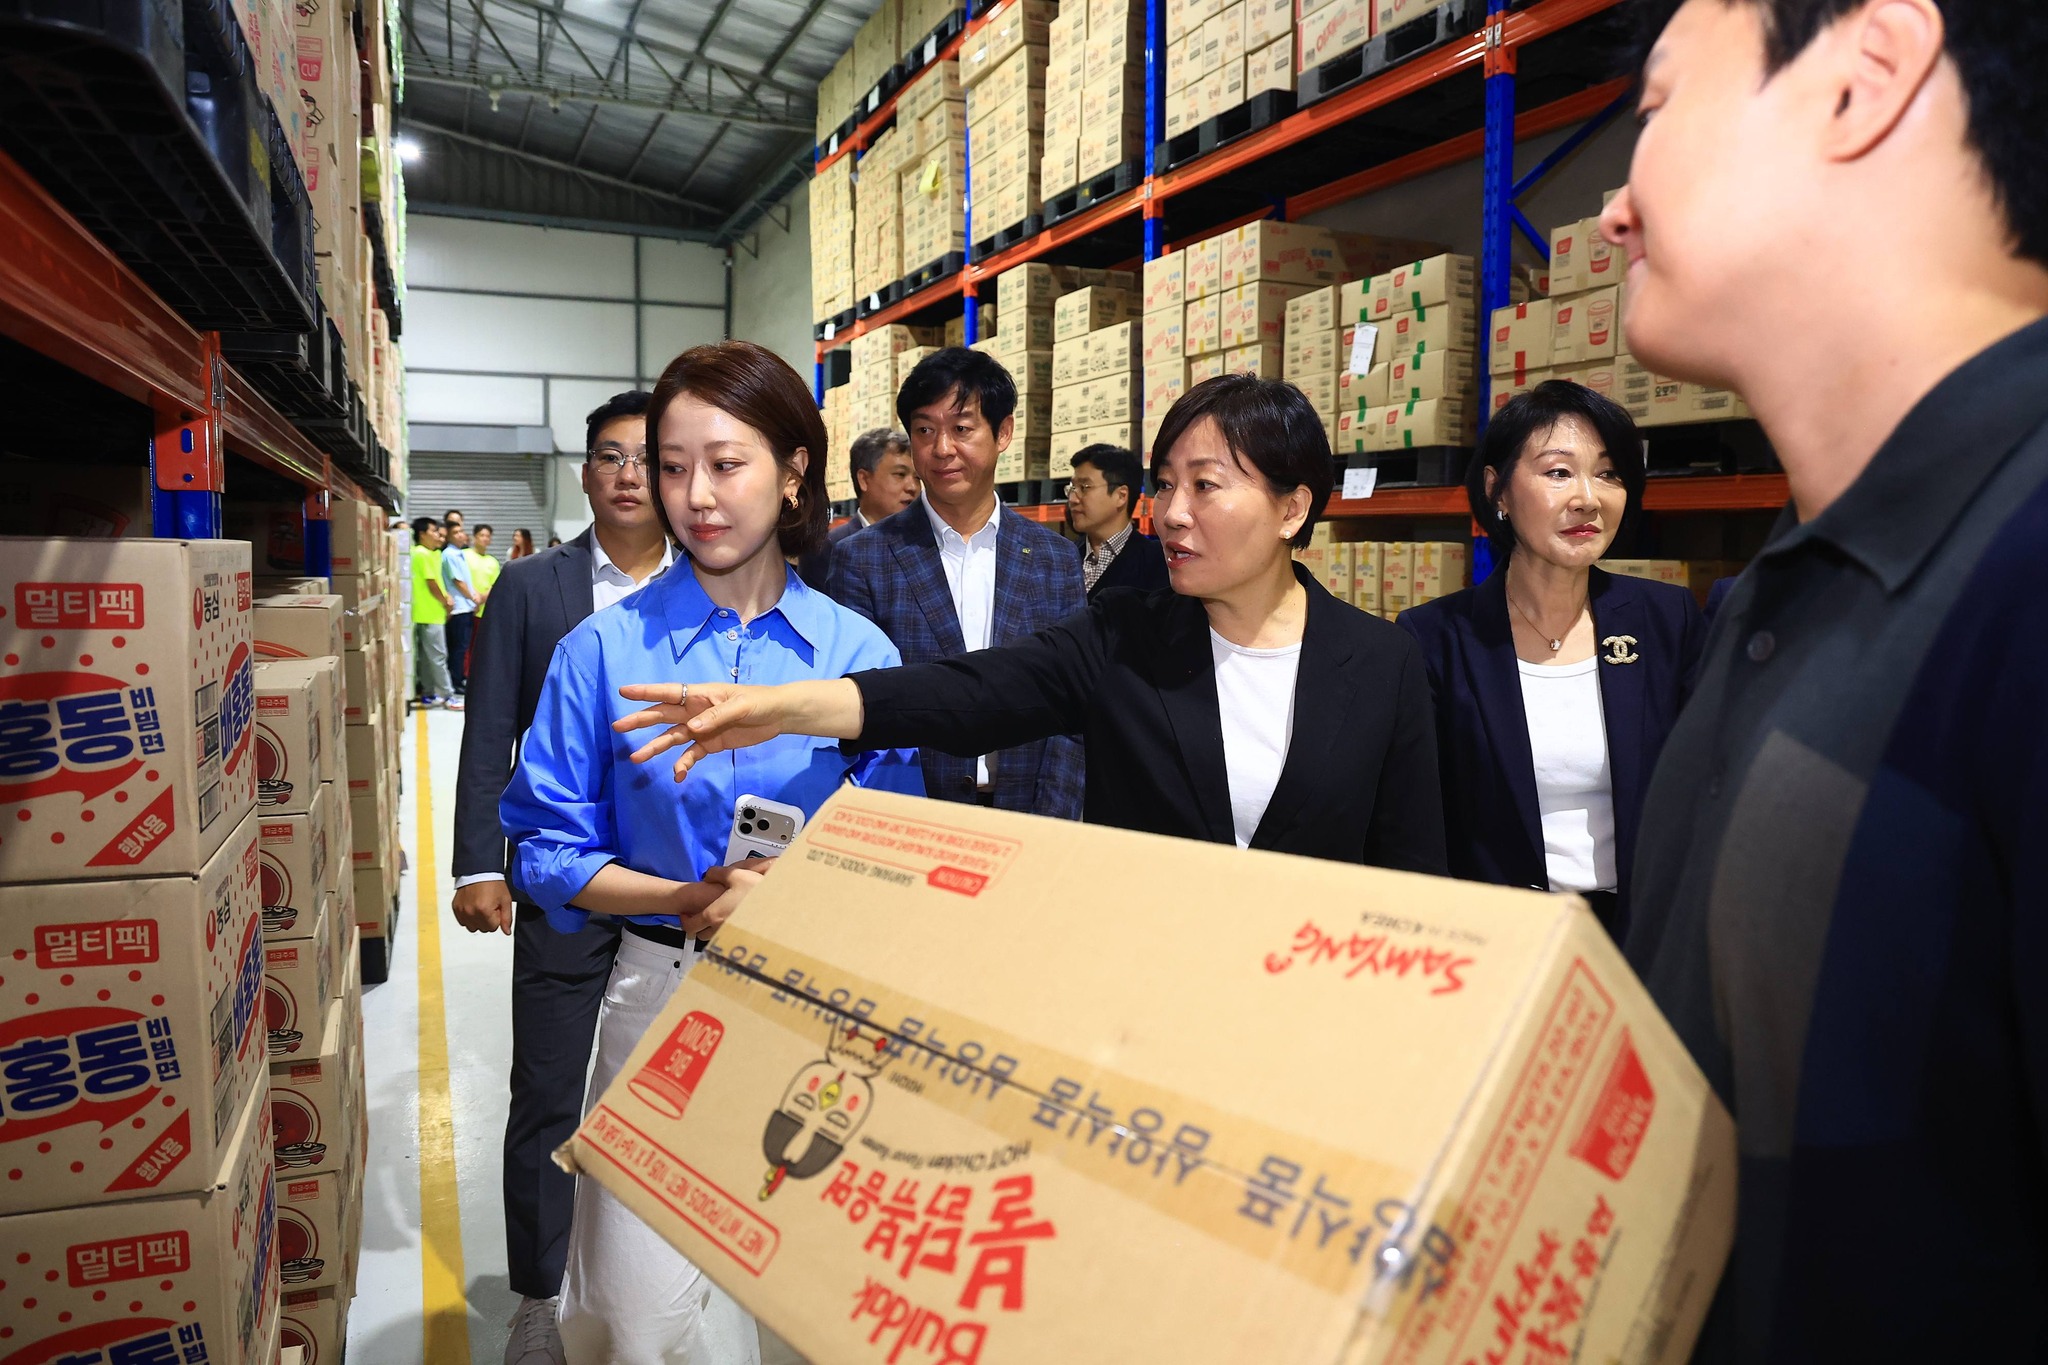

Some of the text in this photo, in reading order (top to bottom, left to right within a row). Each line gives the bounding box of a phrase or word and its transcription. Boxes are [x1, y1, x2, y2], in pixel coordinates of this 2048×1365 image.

[301, 62, 319, 77] CUP
[25, 589, 135, 624] 멀티팩
[204, 589, 220, 623] 농심
[129, 686, 166, 756] 비빔면
[117, 813, 167, 859] 행사용
[935, 869, 983, 892] CAUTION
[216, 891, 230, 935] 농심
[44, 925, 150, 963] 멀티팩
[1291, 919, 1477, 996] SAMYANG
[145, 1016, 182, 1083] 비빔면
[682, 1013, 722, 1057] BOWL
[0, 1023, 152, 1118] 홍동
[662, 1051, 688, 1079] BIG
[885, 1016, 1020, 1100] 삼양식품
[1031, 1076, 1212, 1186] 삼양식품
[135, 1137, 184, 1182] 행사용
[927, 1153, 986, 1174] Chicken
[988, 1139, 1032, 1170] HOT
[820, 1158, 1058, 1312] 불닭볶음면
[76, 1236, 182, 1281] 멀티팩
[177, 1322, 211, 1365] 비빔
